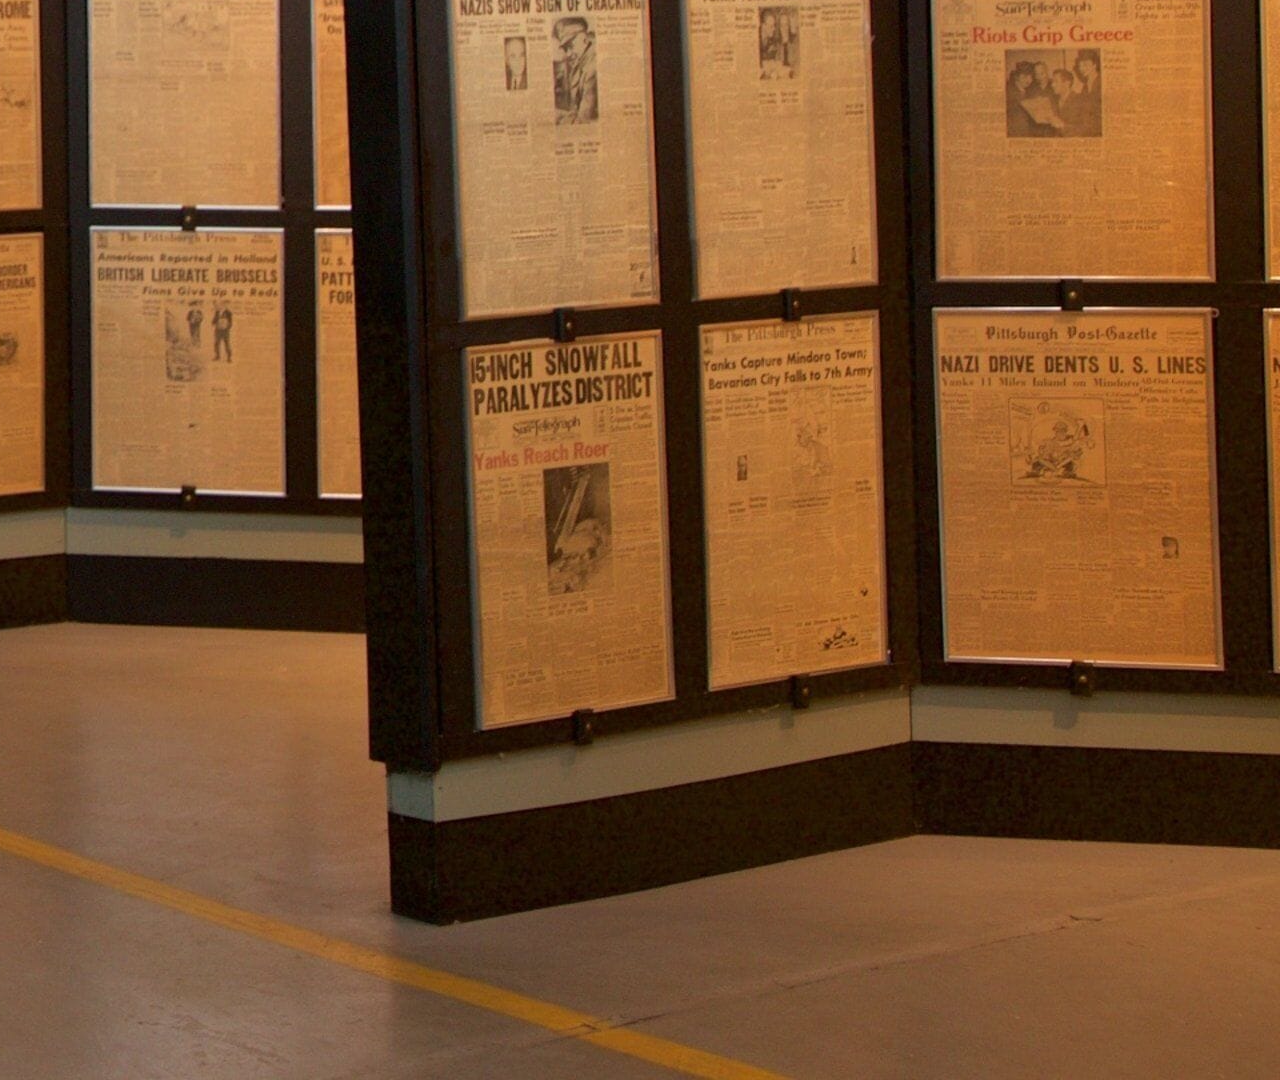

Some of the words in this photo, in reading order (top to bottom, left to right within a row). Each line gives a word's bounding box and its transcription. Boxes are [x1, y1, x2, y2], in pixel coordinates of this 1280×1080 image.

[971, 25, 1017, 44] Riots
[1022, 24, 1064, 45] Grip
[1069, 24, 1134, 42] Greece
[98, 267, 144, 282] BRITISH
[151, 268, 208, 283] LIBERATE
[217, 269, 277, 283] BRUSSELS
[985, 326, 1058, 342] Pittsburgh
[471, 351, 532, 384] 15-INCH
[545, 341, 642, 376] SNOWFALL
[704, 359, 736, 372] Yanks
[741, 357, 782, 371] Capture
[787, 351, 831, 366] Mindoro
[941, 355, 979, 373] NAZI
[989, 355, 1034, 373] DRIVE
[1044, 355, 1100, 374] DENTS
[1109, 356, 1124, 374] U.
[1133, 356, 1148, 374] S.
[1157, 356, 1206, 375] LINES
[708, 375, 757, 390] Bavarian
[760, 372, 781, 387] City
[784, 370, 807, 384] Falls
[810, 369, 820, 381] to
[824, 367, 842, 380] 7th
[845, 366, 873, 380] Army
[474, 379, 573, 415] PARALYZES
[575, 372, 653, 405] DISTRICT
[474, 449, 519, 470] Yanks
[524, 445, 568, 465] Reach
[573, 441, 609, 459] Roer
